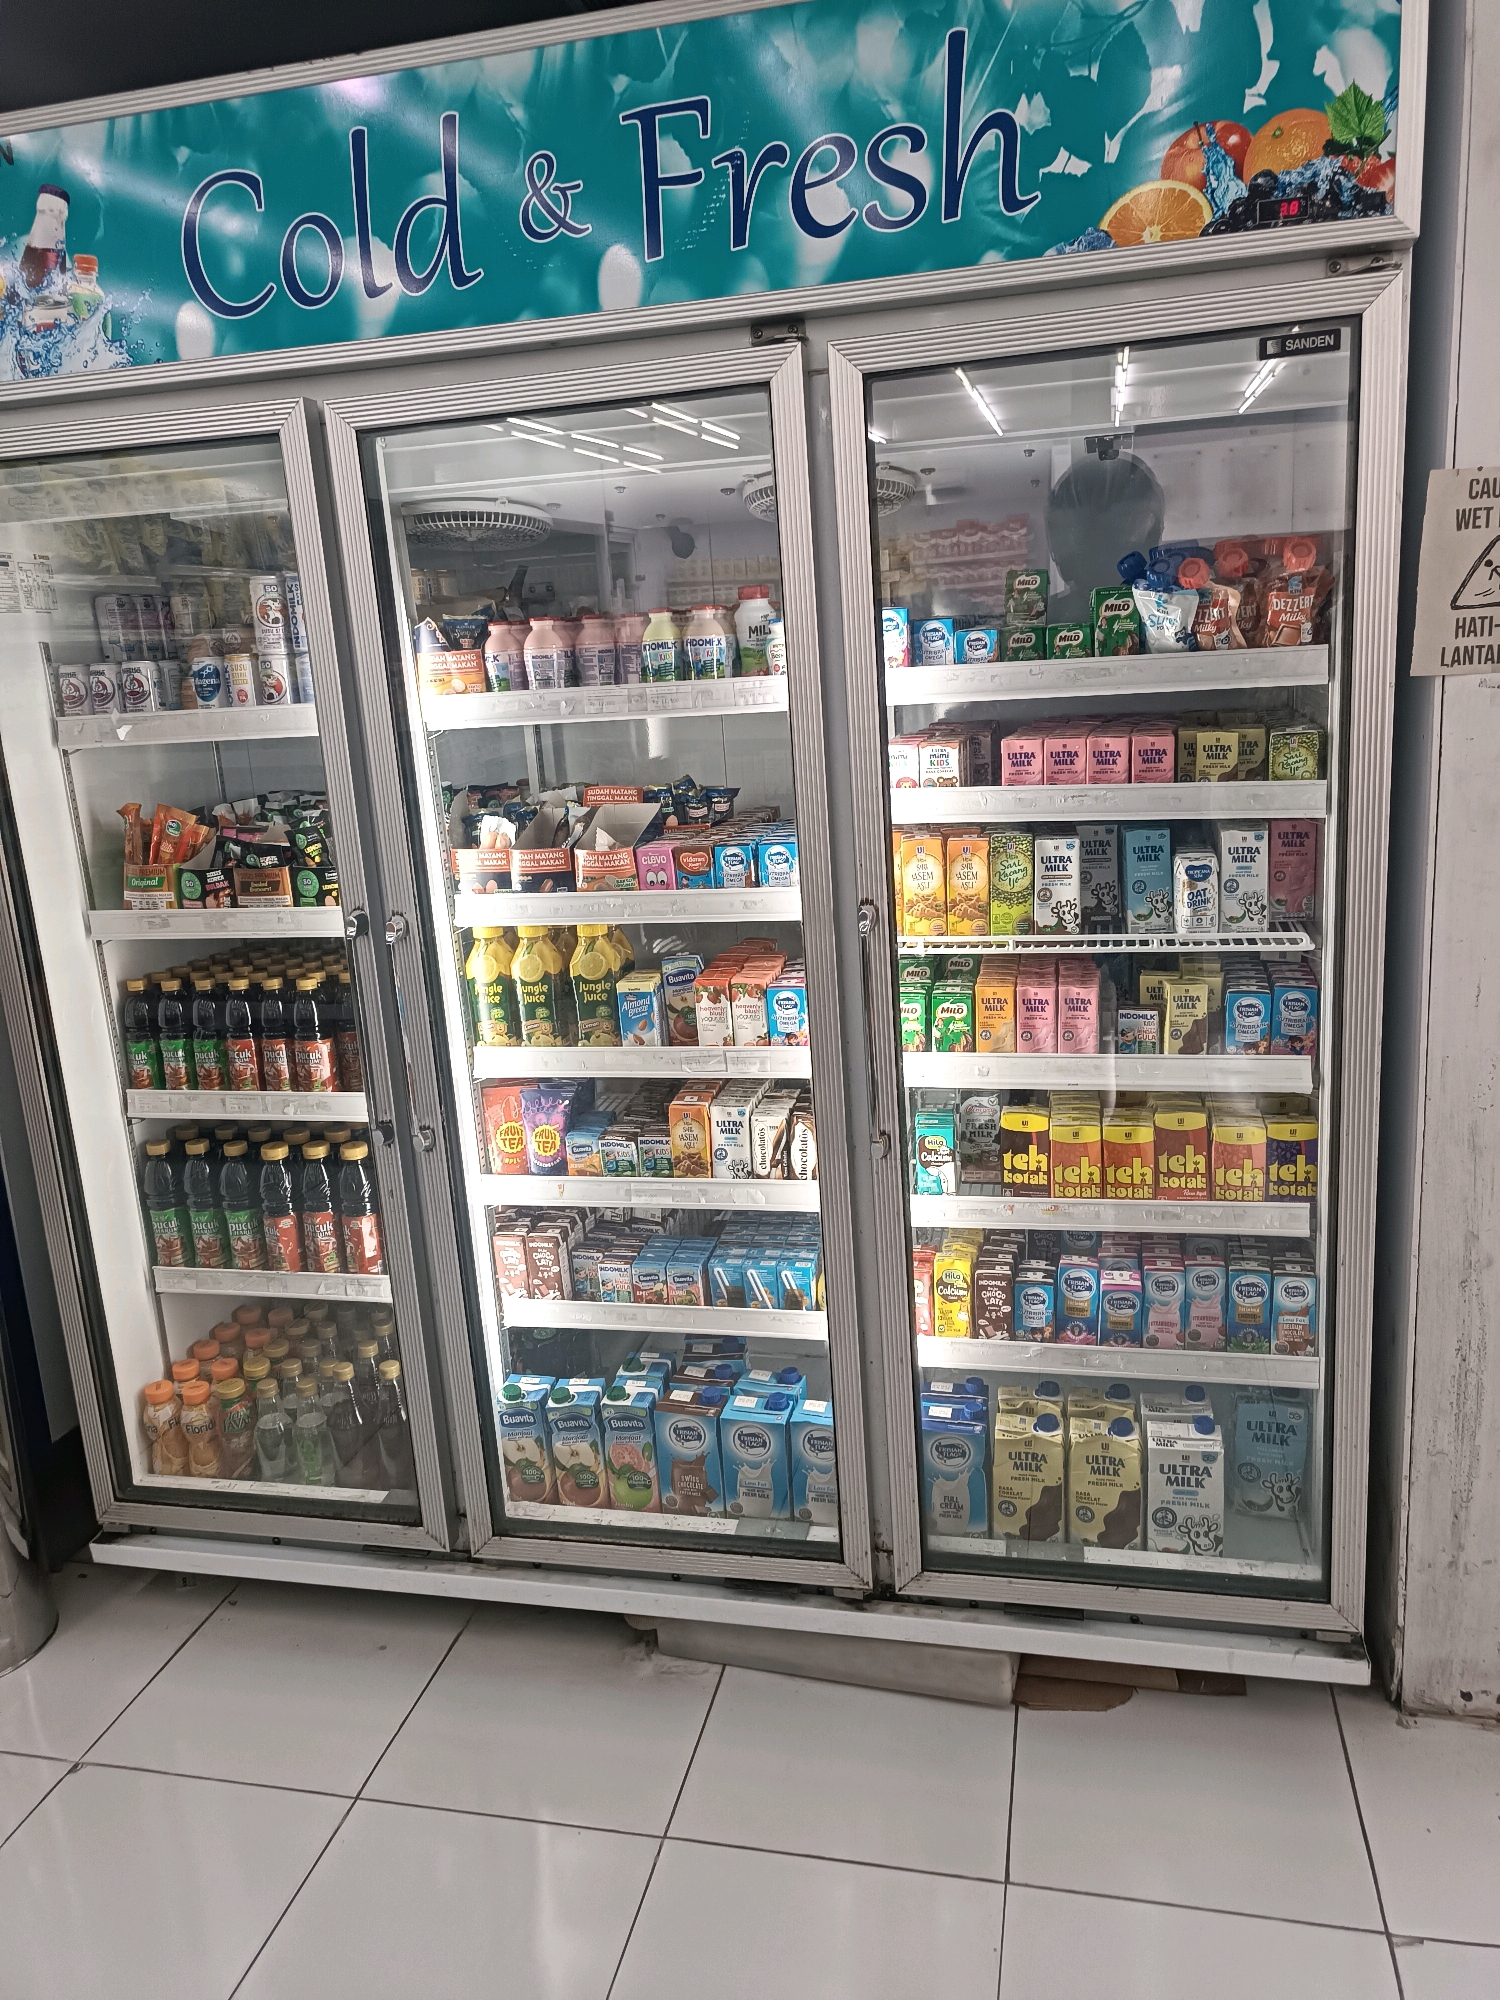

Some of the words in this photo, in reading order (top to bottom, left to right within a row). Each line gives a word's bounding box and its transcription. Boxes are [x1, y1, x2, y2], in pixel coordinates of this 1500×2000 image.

[181, 112, 483, 319] Cold
[520, 151, 591, 242] &
[620, 27, 1041, 261] Fresh
[1286, 334, 1334, 350] SANDEN
[1456, 507, 1493, 531] WET
[1017, 578, 1037, 586] MILO
[1103, 602, 1130, 613] MILO
[1272, 594, 1314, 611] DEZZERT
[287, 584, 300, 648] INDOMILK
[1279, 611, 1306, 623] Milky
[1012, 635, 1033, 644] MILO
[1058, 633, 1079, 641] MILO
[1203, 744, 1232, 753] ULTRA
[1008, 752, 1036, 760] ULTRA
[1050, 750, 1079, 759] ULTRA
[1093, 750, 1121, 759] ULTRA
[1206, 752, 1228, 760] MILK
[1011, 759, 1032, 767] MILK
[1053, 758, 1075, 766] MILK
[1279, 756, 1308, 769] Kacang
[1132, 846, 1164, 855] ULTRA
[1227, 846, 1261, 856] ULTRA
[599, 852, 628, 860] MATANG
[1040, 855, 1073, 864] ULTRA
[1136, 854, 1161, 862] MILK
[1231, 855, 1257, 863] MILK
[999, 859, 1023, 870] Sari
[1044, 864, 1068, 872] MILK
[139, 867, 165, 877] PREMIUM
[254, 871, 280, 879] PREMIUM
[912, 871, 934, 880] ASEM
[995, 865, 1028, 881] Kacang
[132, 877, 159, 886] Original
[1187, 888, 1208, 901] OAT
[1187, 898, 1212, 908] DRINK
[949, 959, 970, 968] MILO
[668, 972, 694, 983] Buavita
[906, 970, 927, 978] MILO
[520, 982, 548, 995] Jungle
[579, 982, 611, 993] Jungle
[524, 993, 545, 1005] Juice
[583, 992, 608, 1001] Juice
[622, 997, 650, 1012] Almond
[984, 1004, 1005, 1012] MILK
[1025, 1005, 1047, 1013] MILK
[1176, 1002, 1197, 1010] MILK
[628, 1005, 648, 1016] Breeze
[940, 1006, 964, 1014] MILO
[1119, 1012, 1157, 1020] INDOMILK
[1137, 1033, 1156, 1041] GULA
[500, 1125, 524, 1138] FRUIT
[534, 1129, 556, 1140] FRUIT
[969, 1130, 993, 1138] MILK
[500, 1138, 524, 1150] TEA
[535, 1140, 556, 1152] TEA
[617, 1150, 630, 1158] KIDS
[1002, 1145, 1048, 1171] teh
[1158, 1145, 1206, 1174] teh
[1053, 1156, 1100, 1184] teh
[1105, 1157, 1153, 1184] teh
[1215, 1158, 1264, 1187] teh
[1268, 1154, 1318, 1182] teh
[1003, 1170, 1048, 1185] kotak
[1159, 1174, 1206, 1189] kotak
[1054, 1185, 1100, 1198] kotak
[1106, 1185, 1153, 1199] kotak
[1215, 1187, 1264, 1201] kotak
[1269, 1183, 1317, 1197] kotak
[304, 1221, 333, 1233] pucuk
[944, 1272, 961, 1280] HiLo
[1067, 1279, 1089, 1287] FRISIAN
[937, 1285, 969, 1297] Calcium
[1238, 1285, 1262, 1293] FRISIAN
[981, 1291, 1006, 1300] CHOCO
[984, 1298, 1003, 1306] LATE
[502, 1414, 534, 1424] Buavita
[557, 1419, 590, 1429] Buavita
[611, 1418, 644, 1429] Buavita
[1247, 1420, 1297, 1435] ULTRA
[1252, 1432, 1291, 1447] MILK
[1008, 1451, 1048, 1464] ULTRA
[1085, 1455, 1125, 1469] ULTRA
[1012, 1461, 1043, 1473] MILK
[1090, 1465, 1121, 1478] MILK
[1159, 1463, 1212, 1478] ULTRA
[677, 1481, 703, 1489] CHOCOLATE
[1165, 1476, 1206, 1488] MILK
[944, 1495, 958, 1504] FULL
[1160, 1499, 1187, 1507] FRESH
[939, 1502, 964, 1512] CREAM
